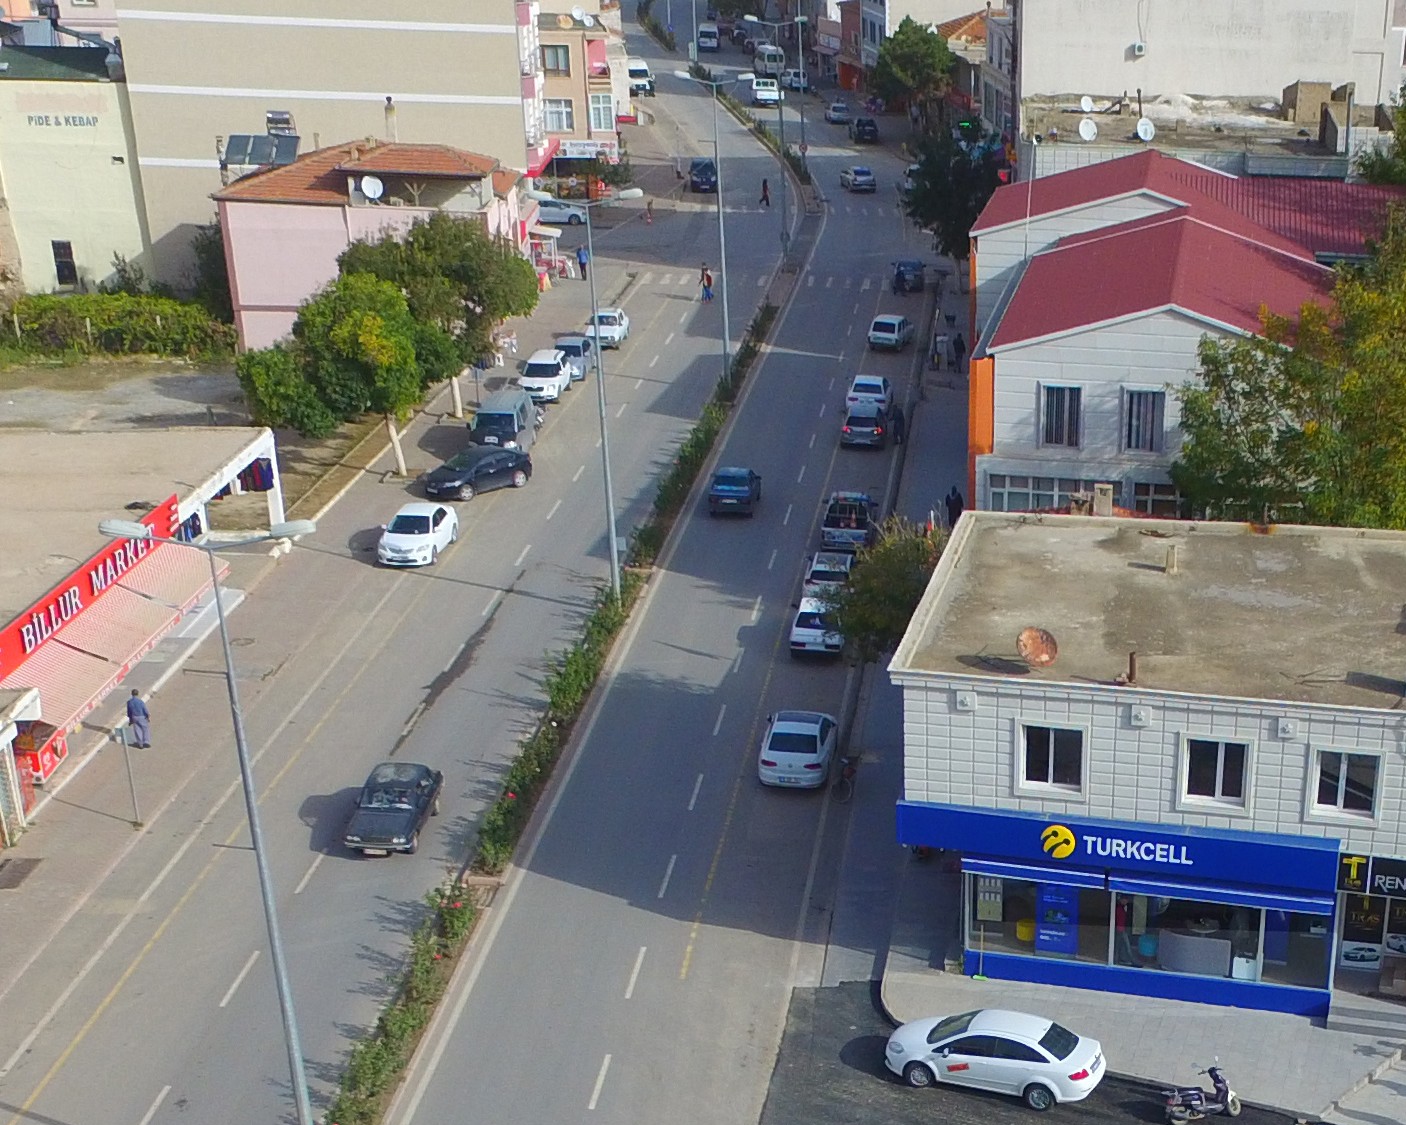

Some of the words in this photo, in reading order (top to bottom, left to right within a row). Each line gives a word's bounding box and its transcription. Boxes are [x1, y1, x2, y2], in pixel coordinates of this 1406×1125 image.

[55, 116, 62, 126] &
[64, 115, 99, 127] KEBAP
[20, 586, 83, 654] BİLLUR
[90, 523, 155, 597] MARKET
[1083, 835, 1193, 865] TURKCELL
